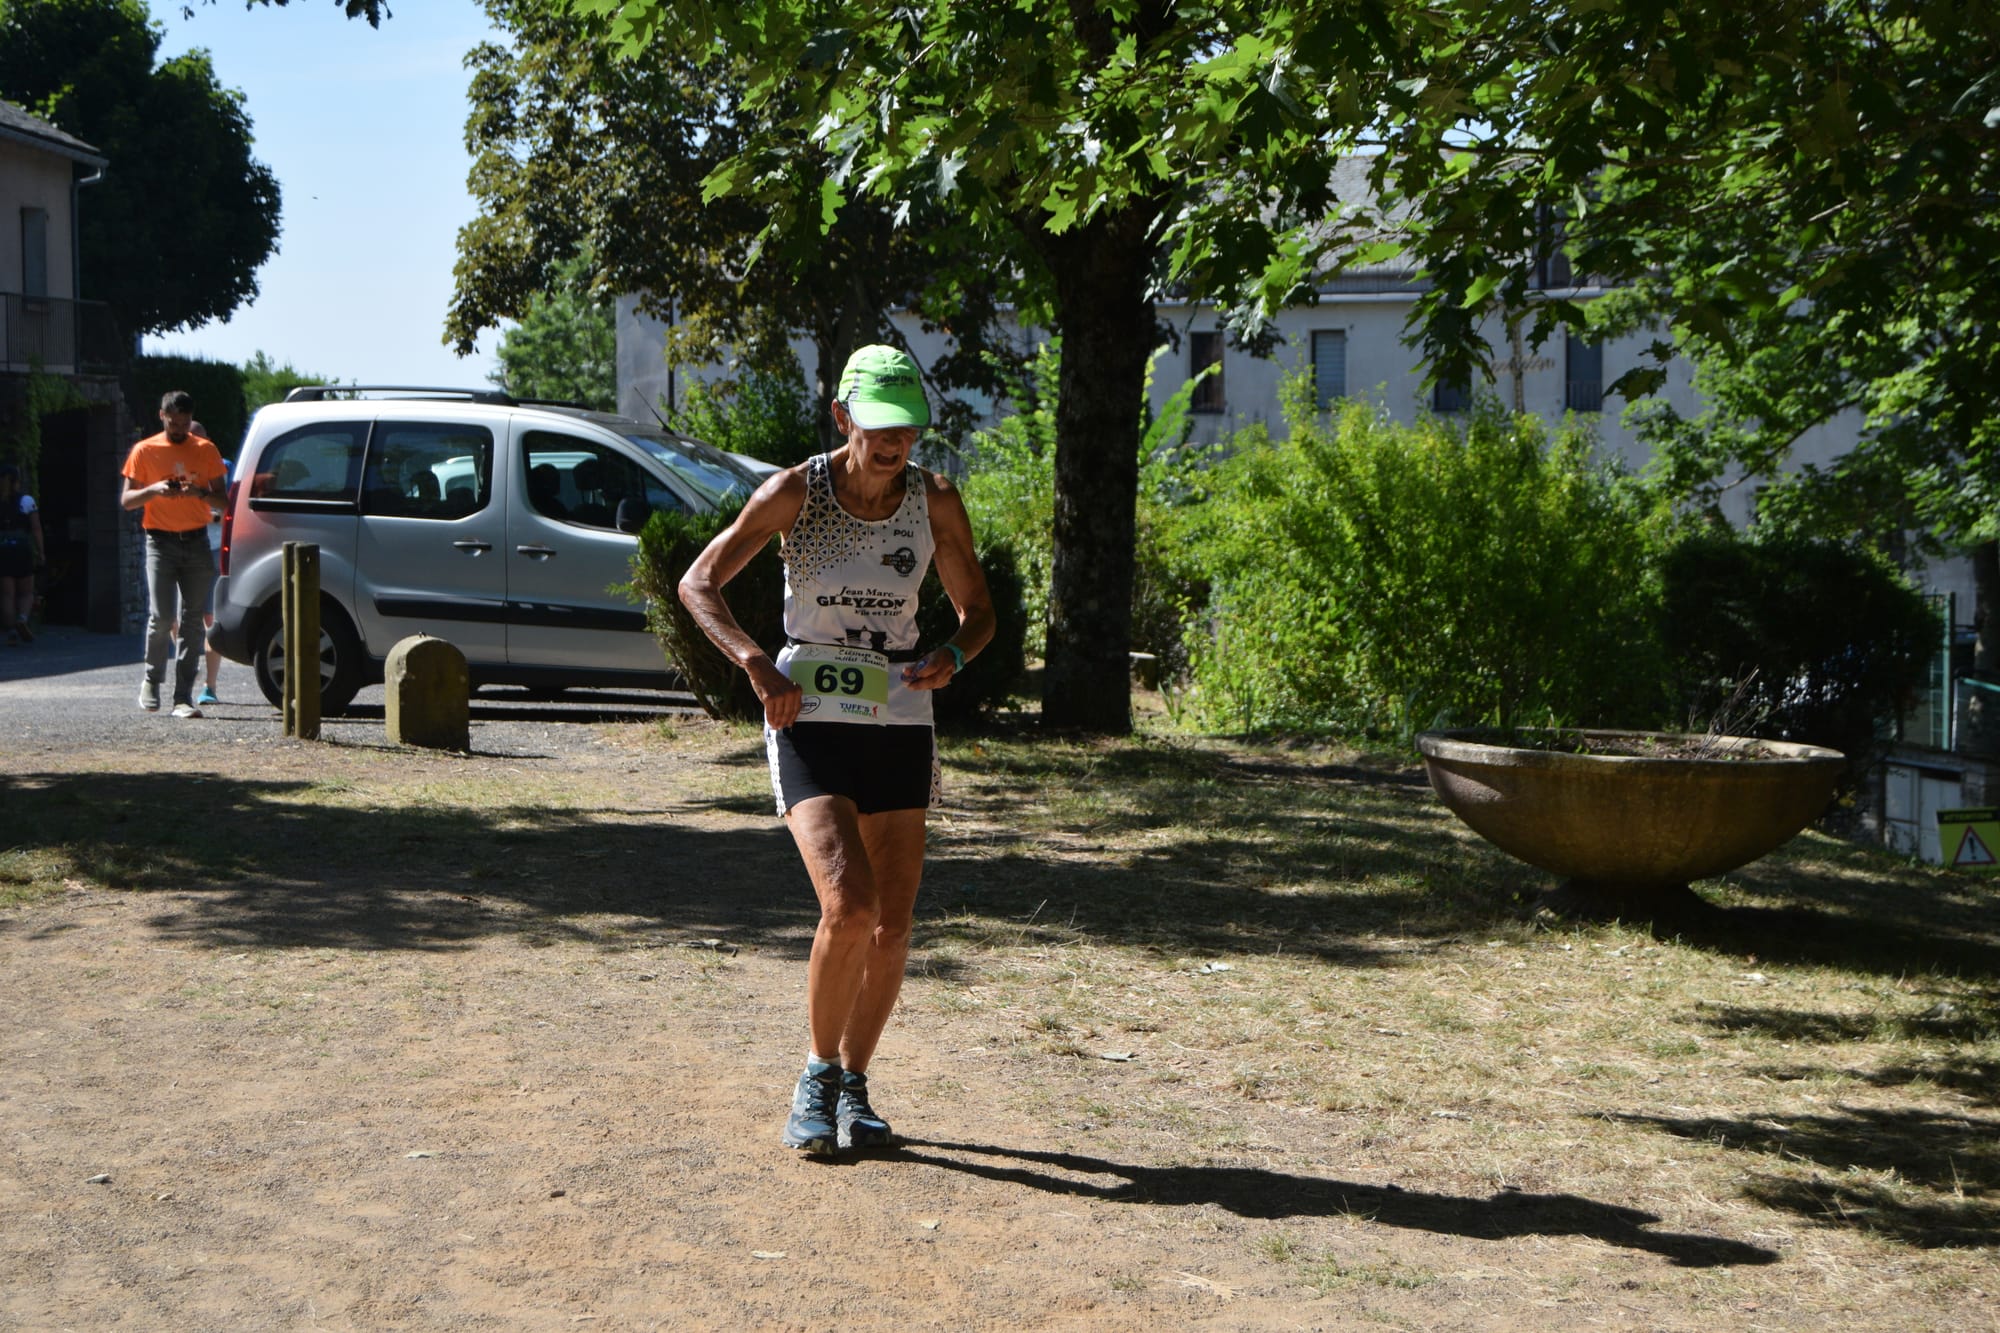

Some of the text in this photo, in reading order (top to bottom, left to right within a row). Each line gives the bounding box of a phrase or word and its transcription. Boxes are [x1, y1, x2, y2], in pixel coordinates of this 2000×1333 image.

[838, 586, 894, 597] Jean Marc
[816, 595, 906, 609] GLEYZON
[814, 664, 864, 695] 69
